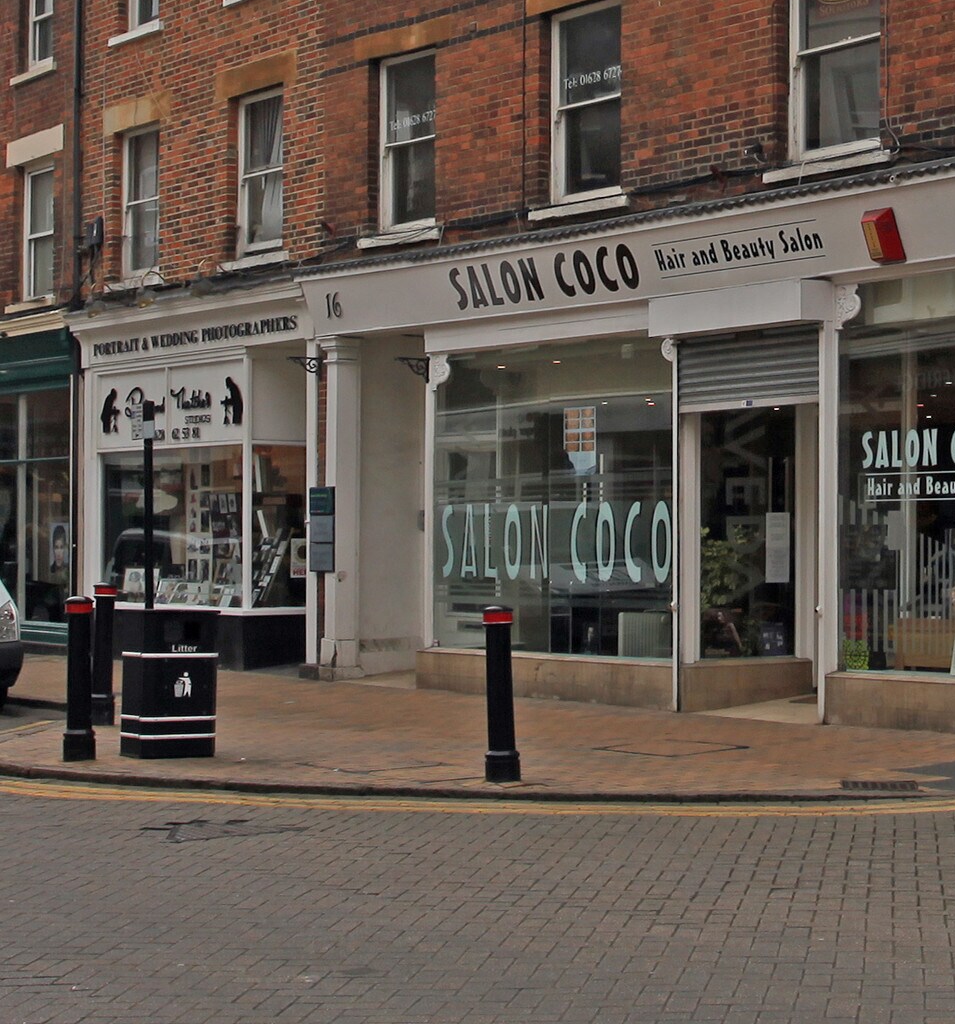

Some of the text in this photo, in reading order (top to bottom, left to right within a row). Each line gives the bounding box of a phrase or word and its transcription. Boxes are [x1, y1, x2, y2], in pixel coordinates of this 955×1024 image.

[579, 71, 602, 86] 01628
[653, 227, 824, 272] Hair and Beauty Salon
[449, 243, 640, 311] SALON COCO
[325, 291, 344, 319] 16
[93, 315, 299, 357] PORTRAIT & WEDDING PHOTOGRAPHERS
[184, 414, 212, 425] STUDIOS
[861, 428, 938, 469] SALON
[866, 478, 893, 497] Hair
[897, 476, 921, 496] and
[441, 502, 549, 581] SALON
[570, 500, 672, 584] COCO
[171, 644, 198, 653] Litter
